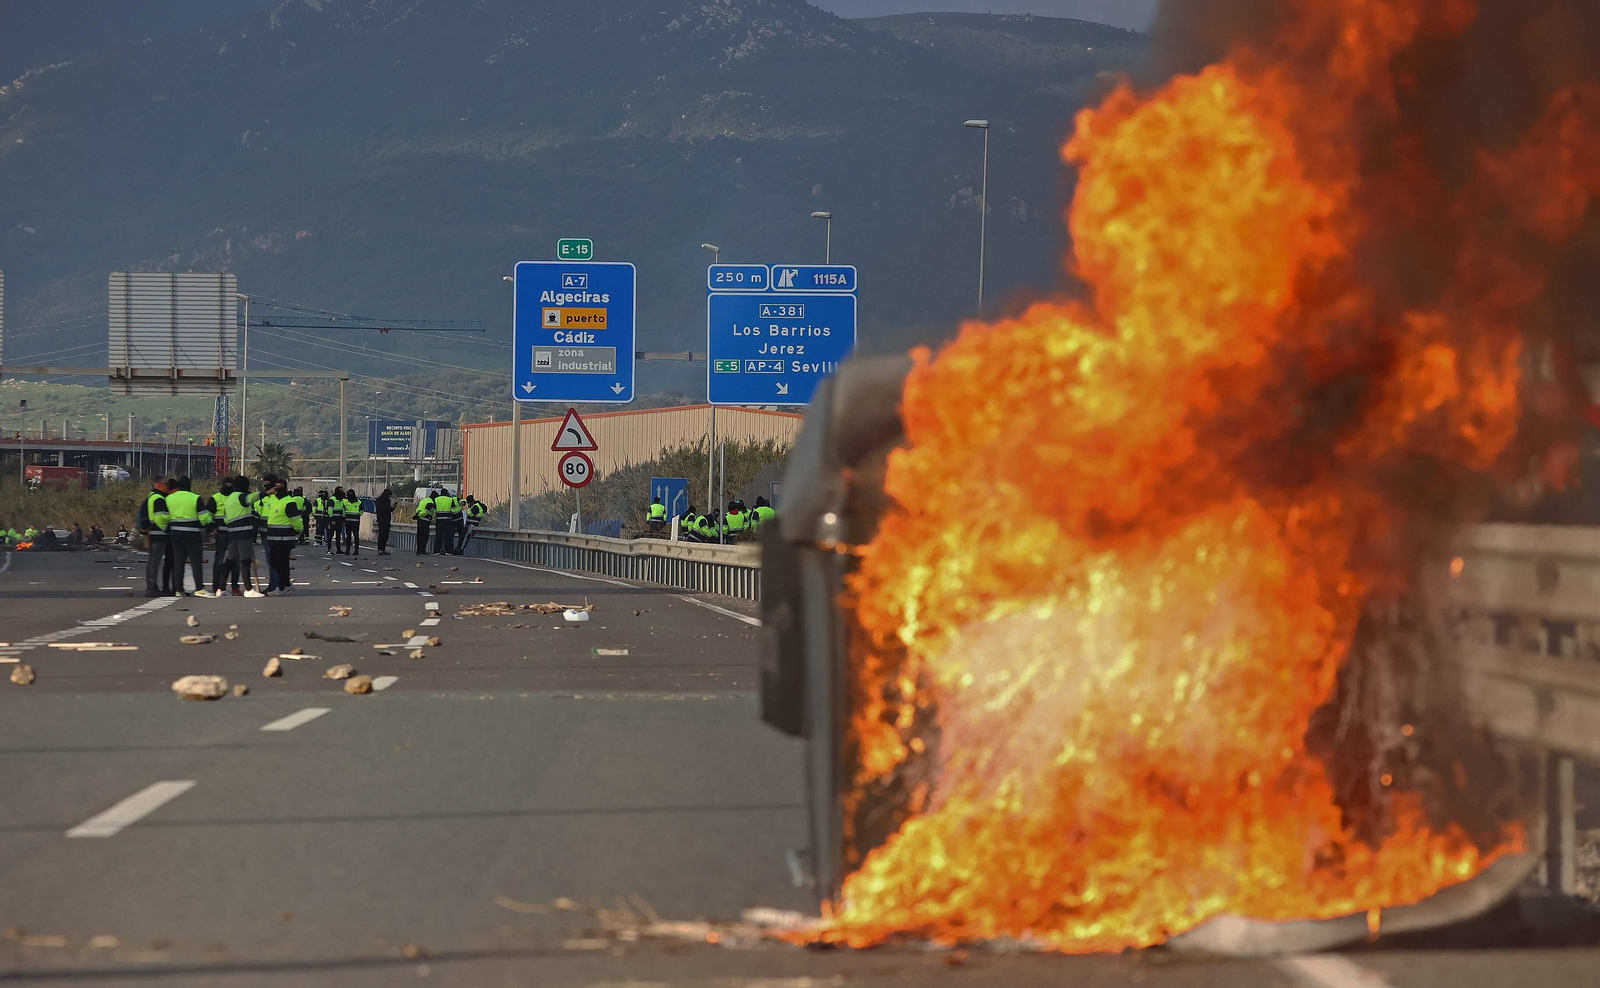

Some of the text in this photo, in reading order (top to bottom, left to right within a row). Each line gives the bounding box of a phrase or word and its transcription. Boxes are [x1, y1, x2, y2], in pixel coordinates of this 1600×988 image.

[562, 245, 588, 254] E-15
[565, 276, 586, 286] A-7
[716, 273, 762, 283] 250 m
[814, 274, 847, 285] 1115A
[540, 290, 610, 306] Algeciras
[762, 306, 803, 317] A-381
[566, 314, 605, 324] puerto
[733, 324, 831, 337] Los Barrios
[553, 331, 595, 344] Cádiz
[558, 349, 584, 357] zona
[758, 342, 805, 355] Jerez
[558, 361, 612, 371] industrial
[716, 361, 838, 373] E-5 AP-4 Sevill
[565, 462, 586, 475] 80
